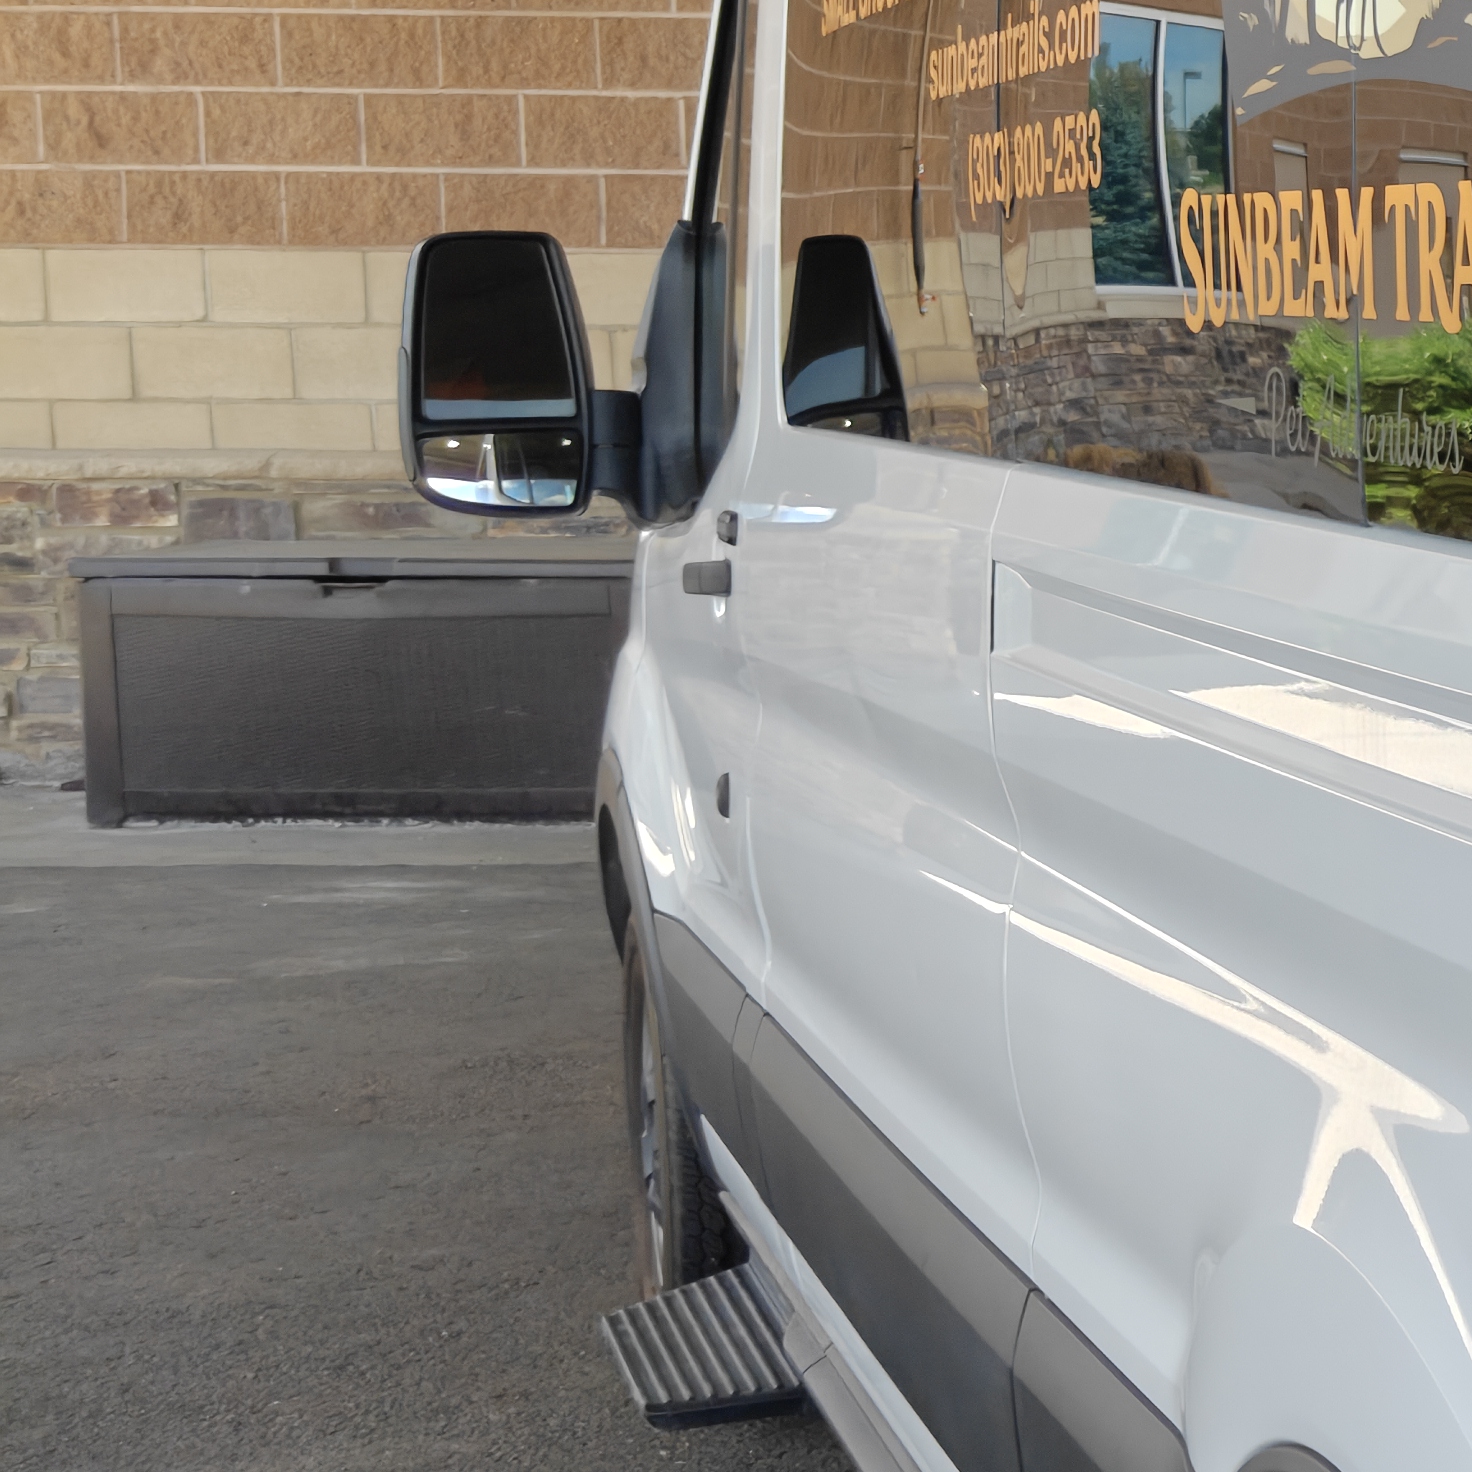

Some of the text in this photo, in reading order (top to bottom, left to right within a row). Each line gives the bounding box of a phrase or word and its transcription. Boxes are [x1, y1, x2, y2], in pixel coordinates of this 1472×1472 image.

[968, 108, 1101, 222] (303) 800-2533
[1179, 186, 1378, 335] SUNBEAM
[1263, 366, 1312, 459] Pet
